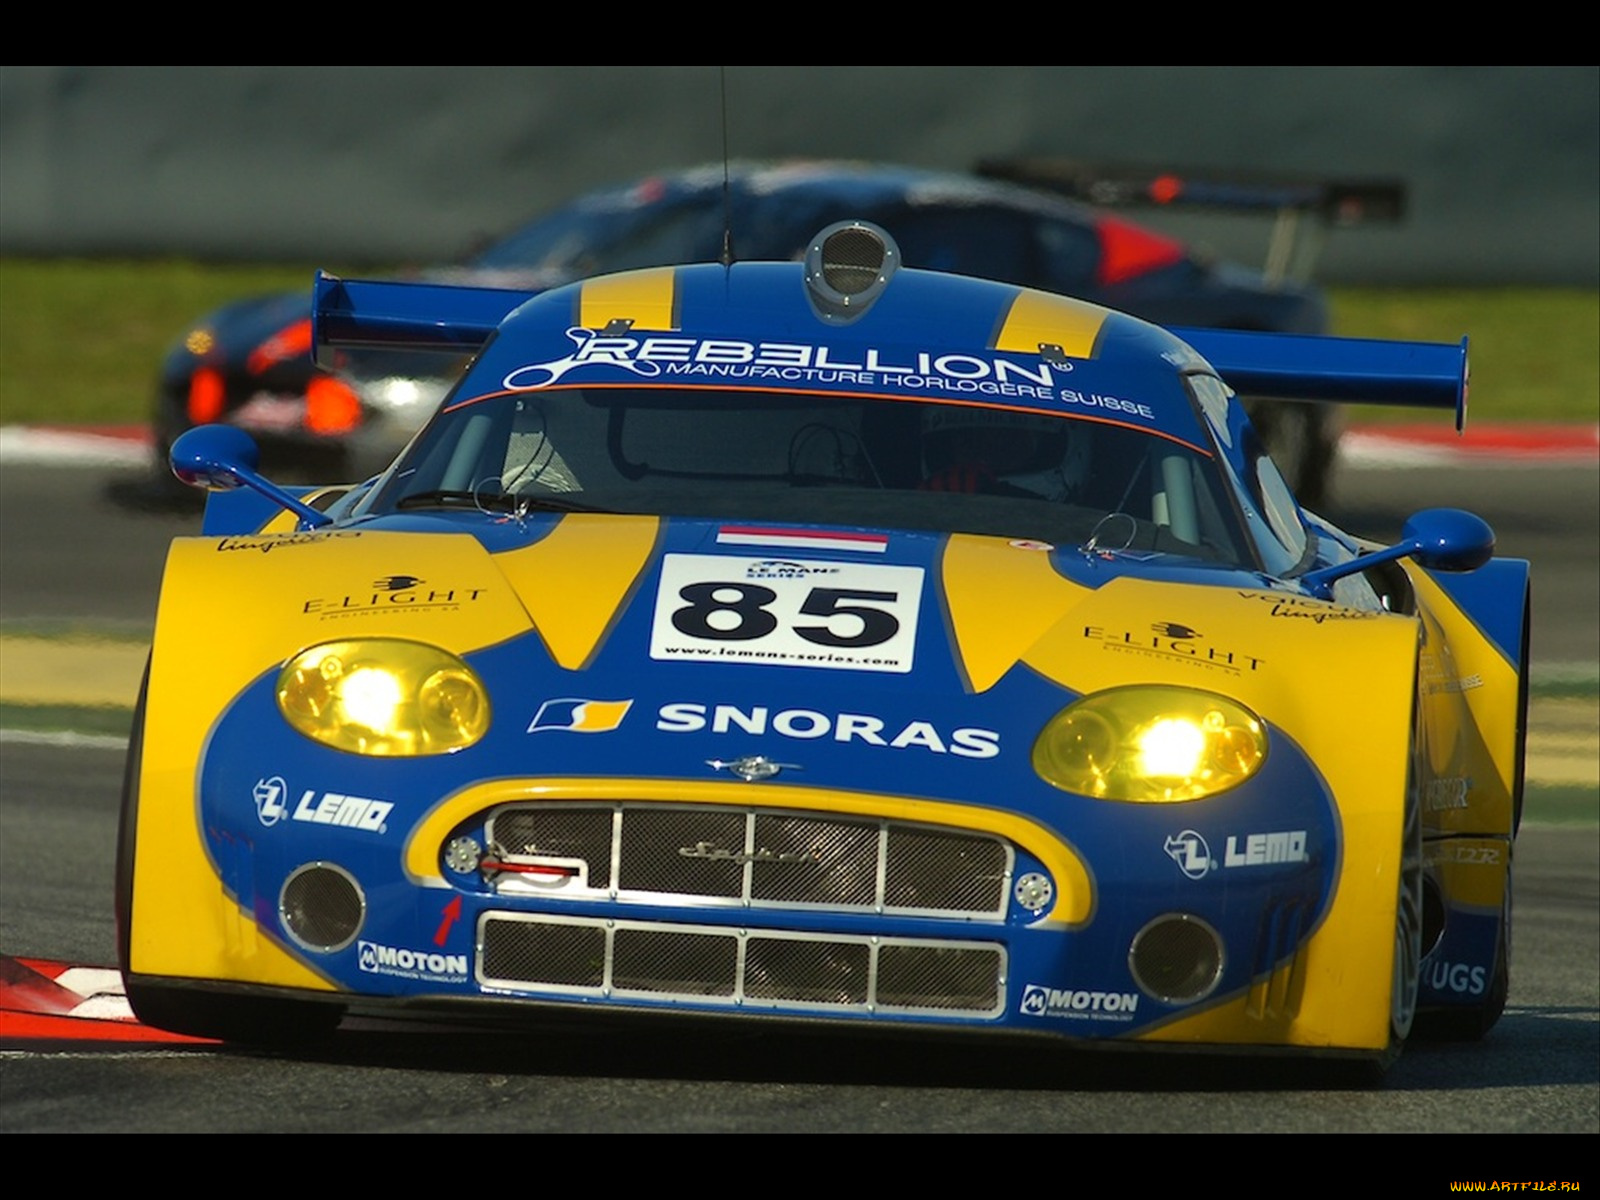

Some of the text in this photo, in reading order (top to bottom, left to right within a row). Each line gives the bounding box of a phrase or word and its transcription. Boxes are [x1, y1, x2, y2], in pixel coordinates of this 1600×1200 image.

[576, 337, 1054, 387] REBELLION
[665, 362, 874, 386] MANUFACTURE
[1061, 389, 1155, 420] SUISSE
[302, 588, 488, 614] E-LIGHT
[670, 581, 900, 648] 85
[664, 646, 900, 667] www.lemans-series.com
[1083, 625, 1267, 672] E-LIGHT
[656, 702, 1001, 760] SNORAS
[292, 790, 395, 833] LEMO
[1224, 829, 1308, 868] LEMO
[378, 945, 468, 974] MOTON
[1048, 988, 1139, 1013] MOTON
